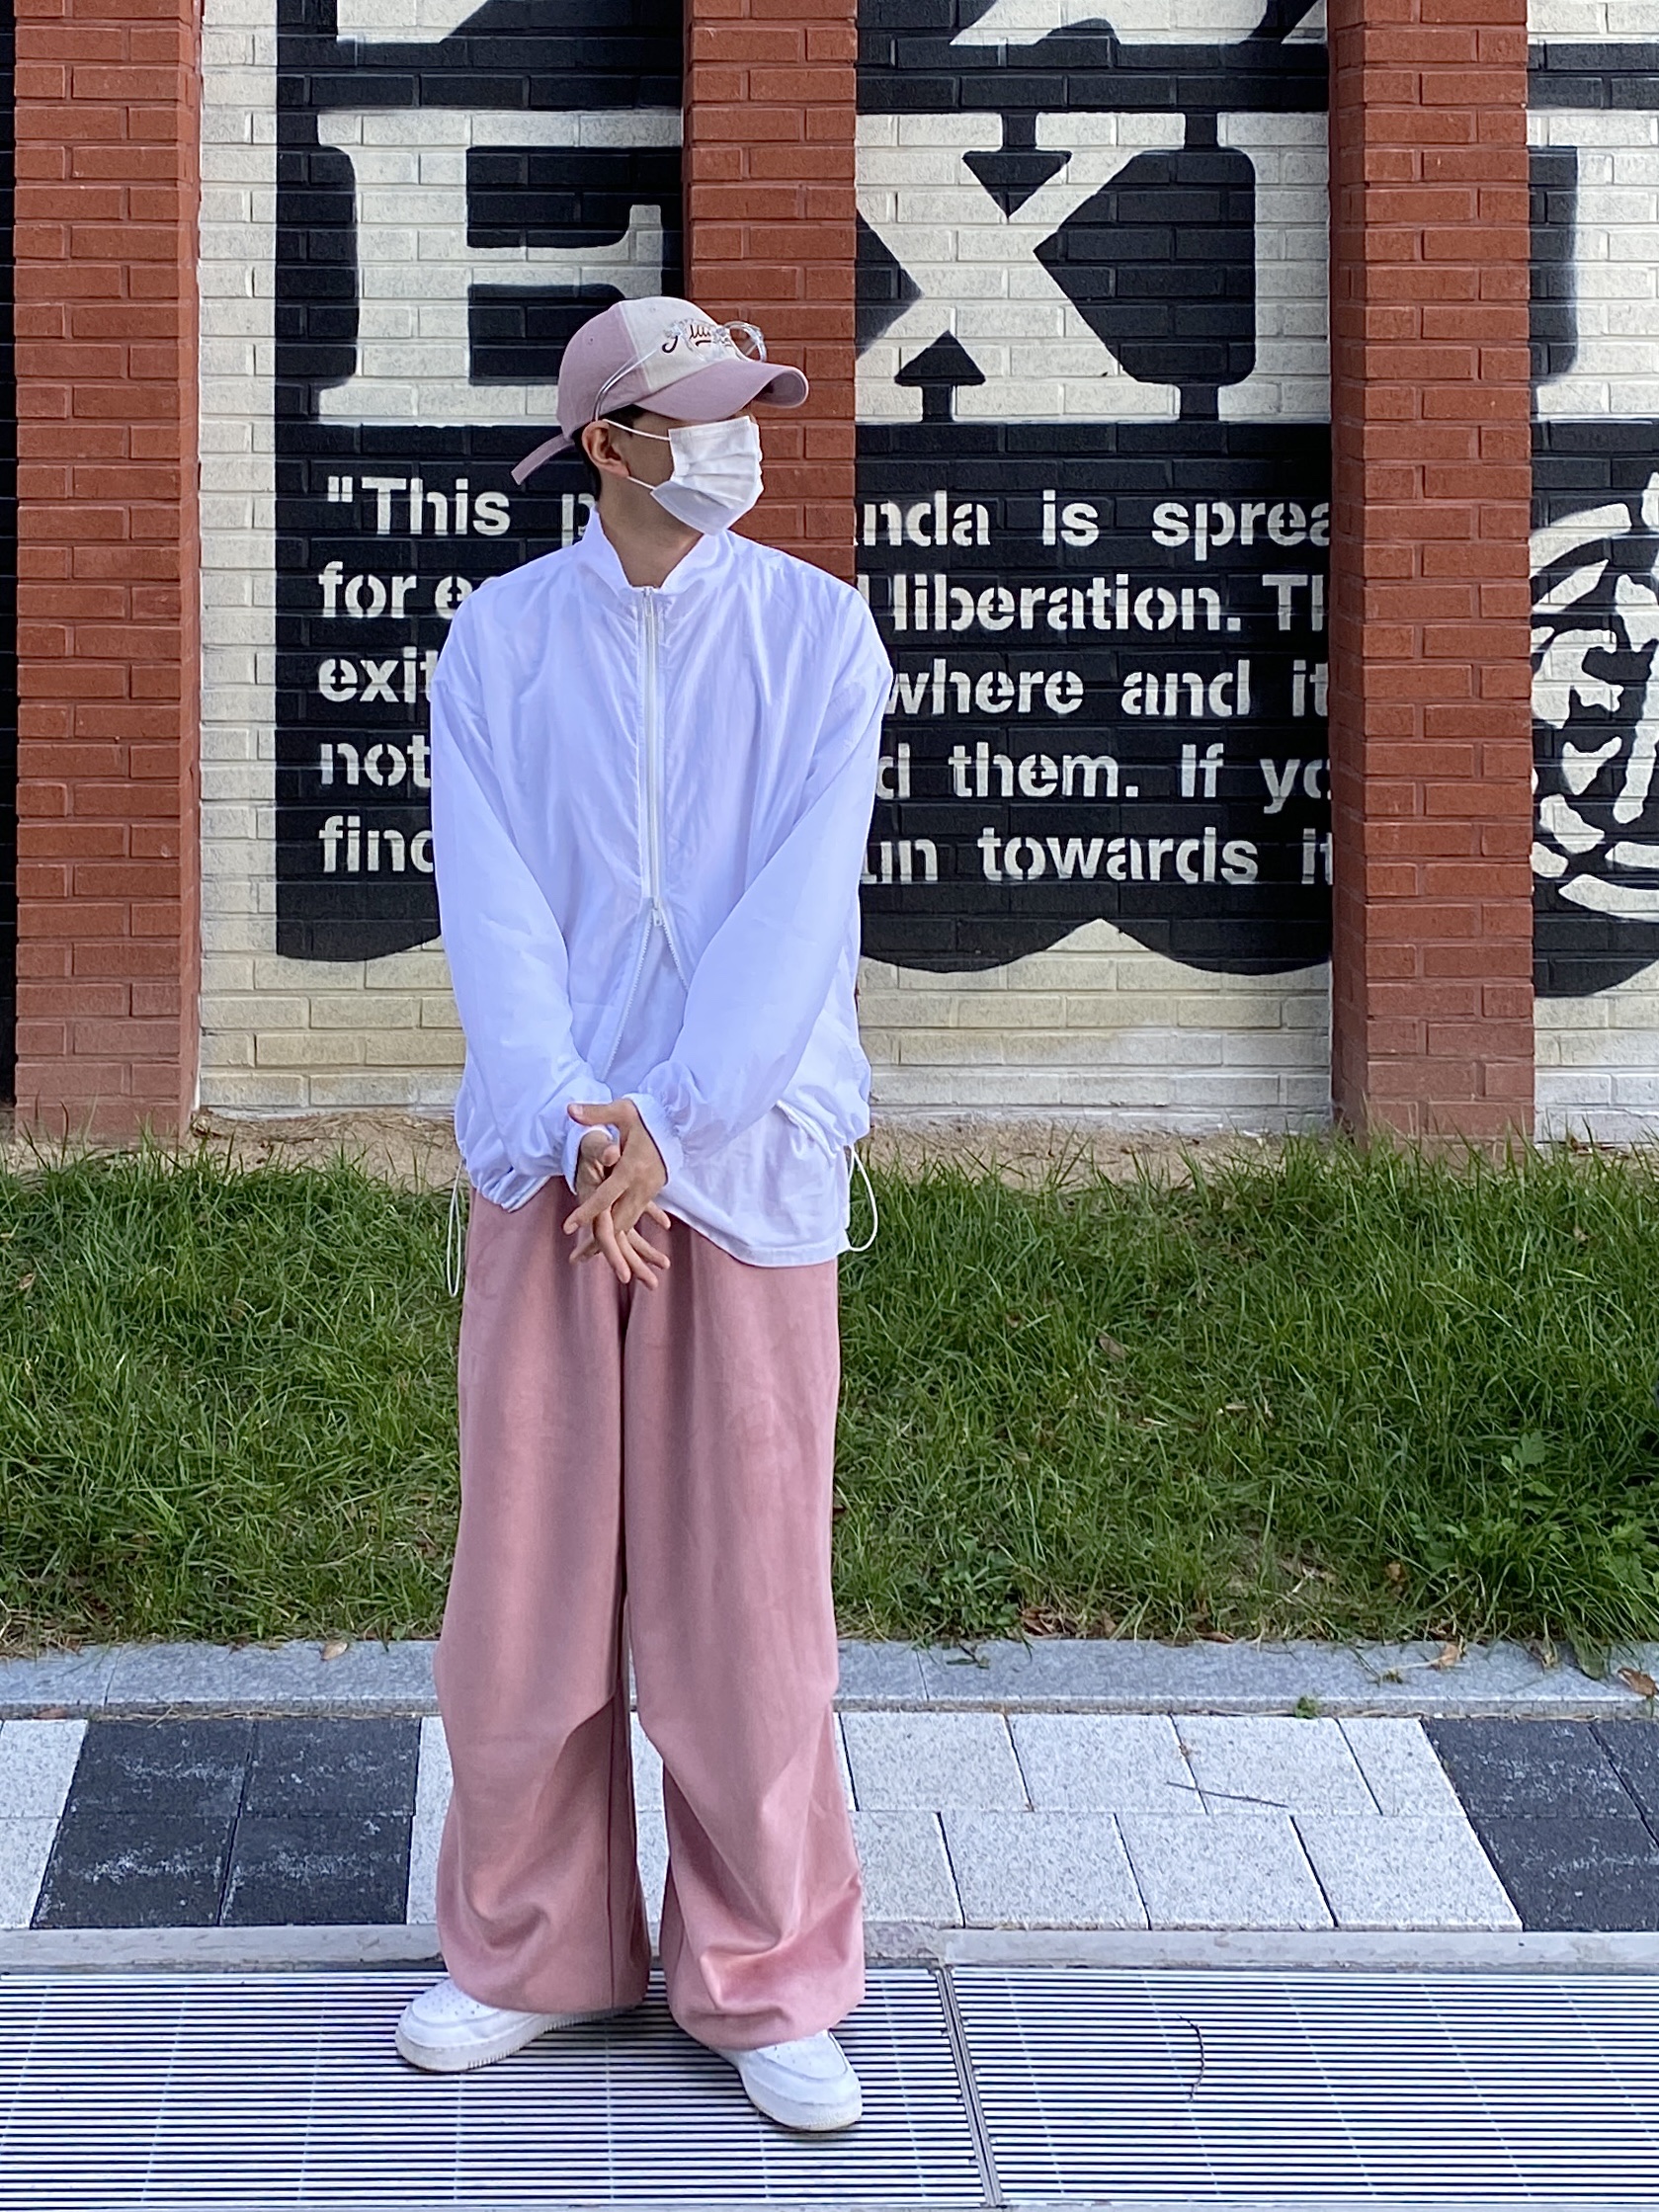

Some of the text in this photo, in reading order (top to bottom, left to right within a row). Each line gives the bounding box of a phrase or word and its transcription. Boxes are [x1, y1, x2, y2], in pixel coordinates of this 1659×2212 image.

[327, 475, 511, 536] "This
[1043, 490, 1100, 547] is
[318, 561, 417, 618] for
[893, 573, 1242, 631] liberation.
[1121, 659, 1251, 717] and
[320, 734, 432, 787] not
[948, 742, 1139, 799] them.
[1181, 743, 1225, 799] If
[977, 827, 1260, 885] towards
